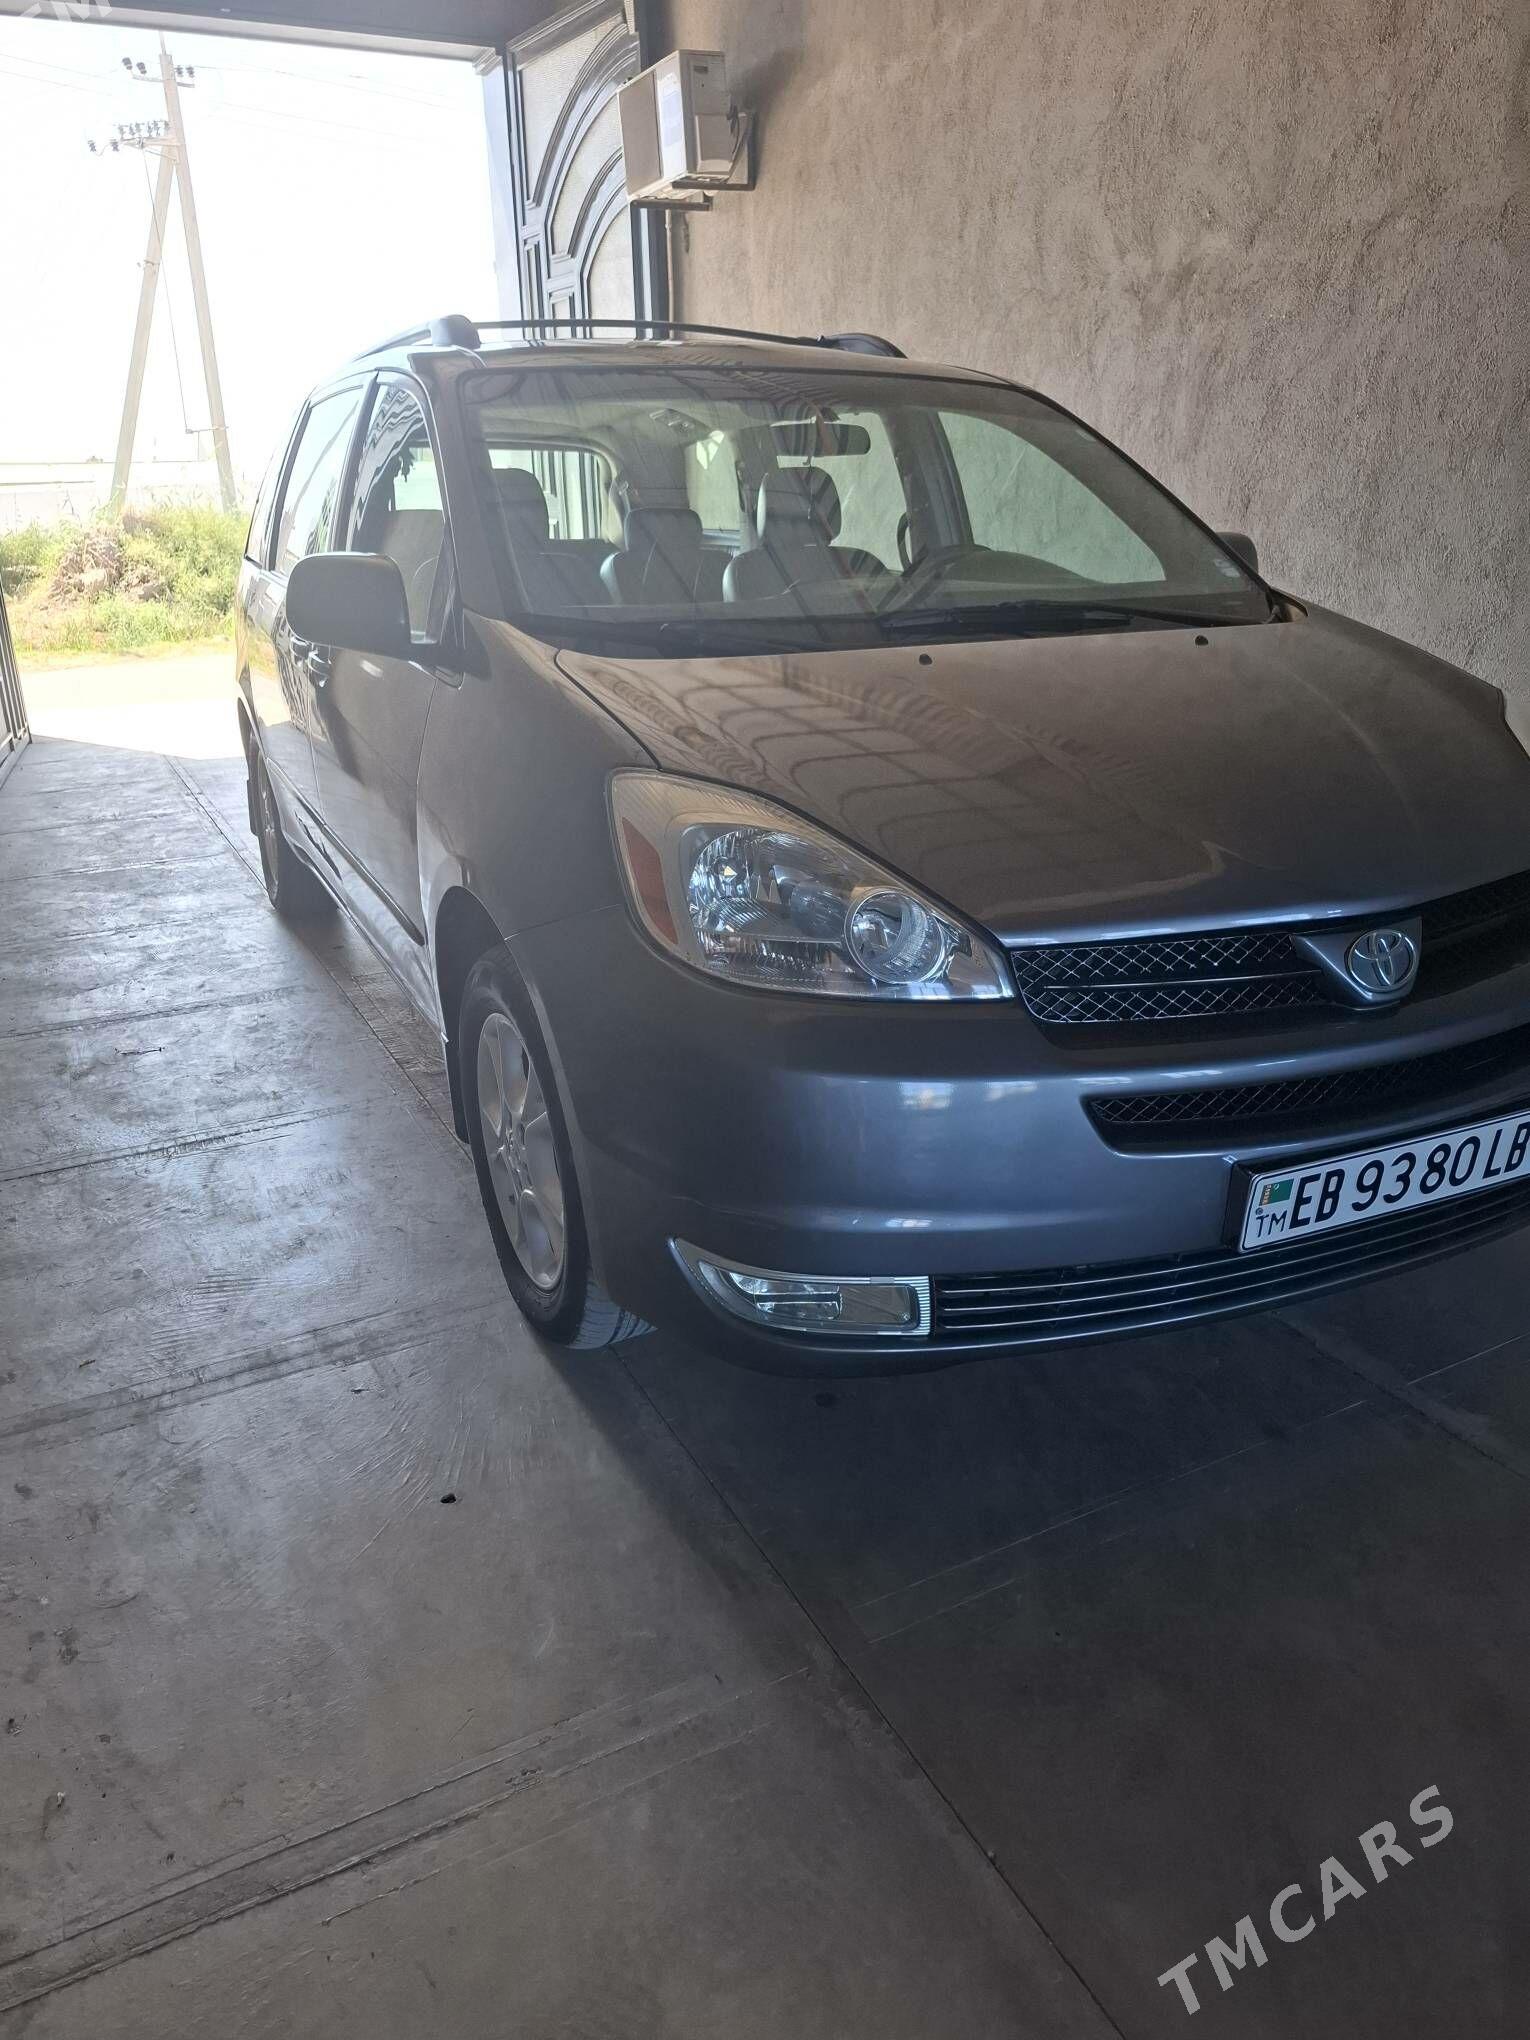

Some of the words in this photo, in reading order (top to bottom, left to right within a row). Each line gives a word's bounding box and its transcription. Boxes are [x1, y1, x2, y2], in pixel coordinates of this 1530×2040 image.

[1288, 1168, 1346, 1230] EB
[1351, 1135, 1481, 1212] 9380
[1482, 1121, 1530, 1179] LB
[1255, 1209, 1287, 1238] TM
